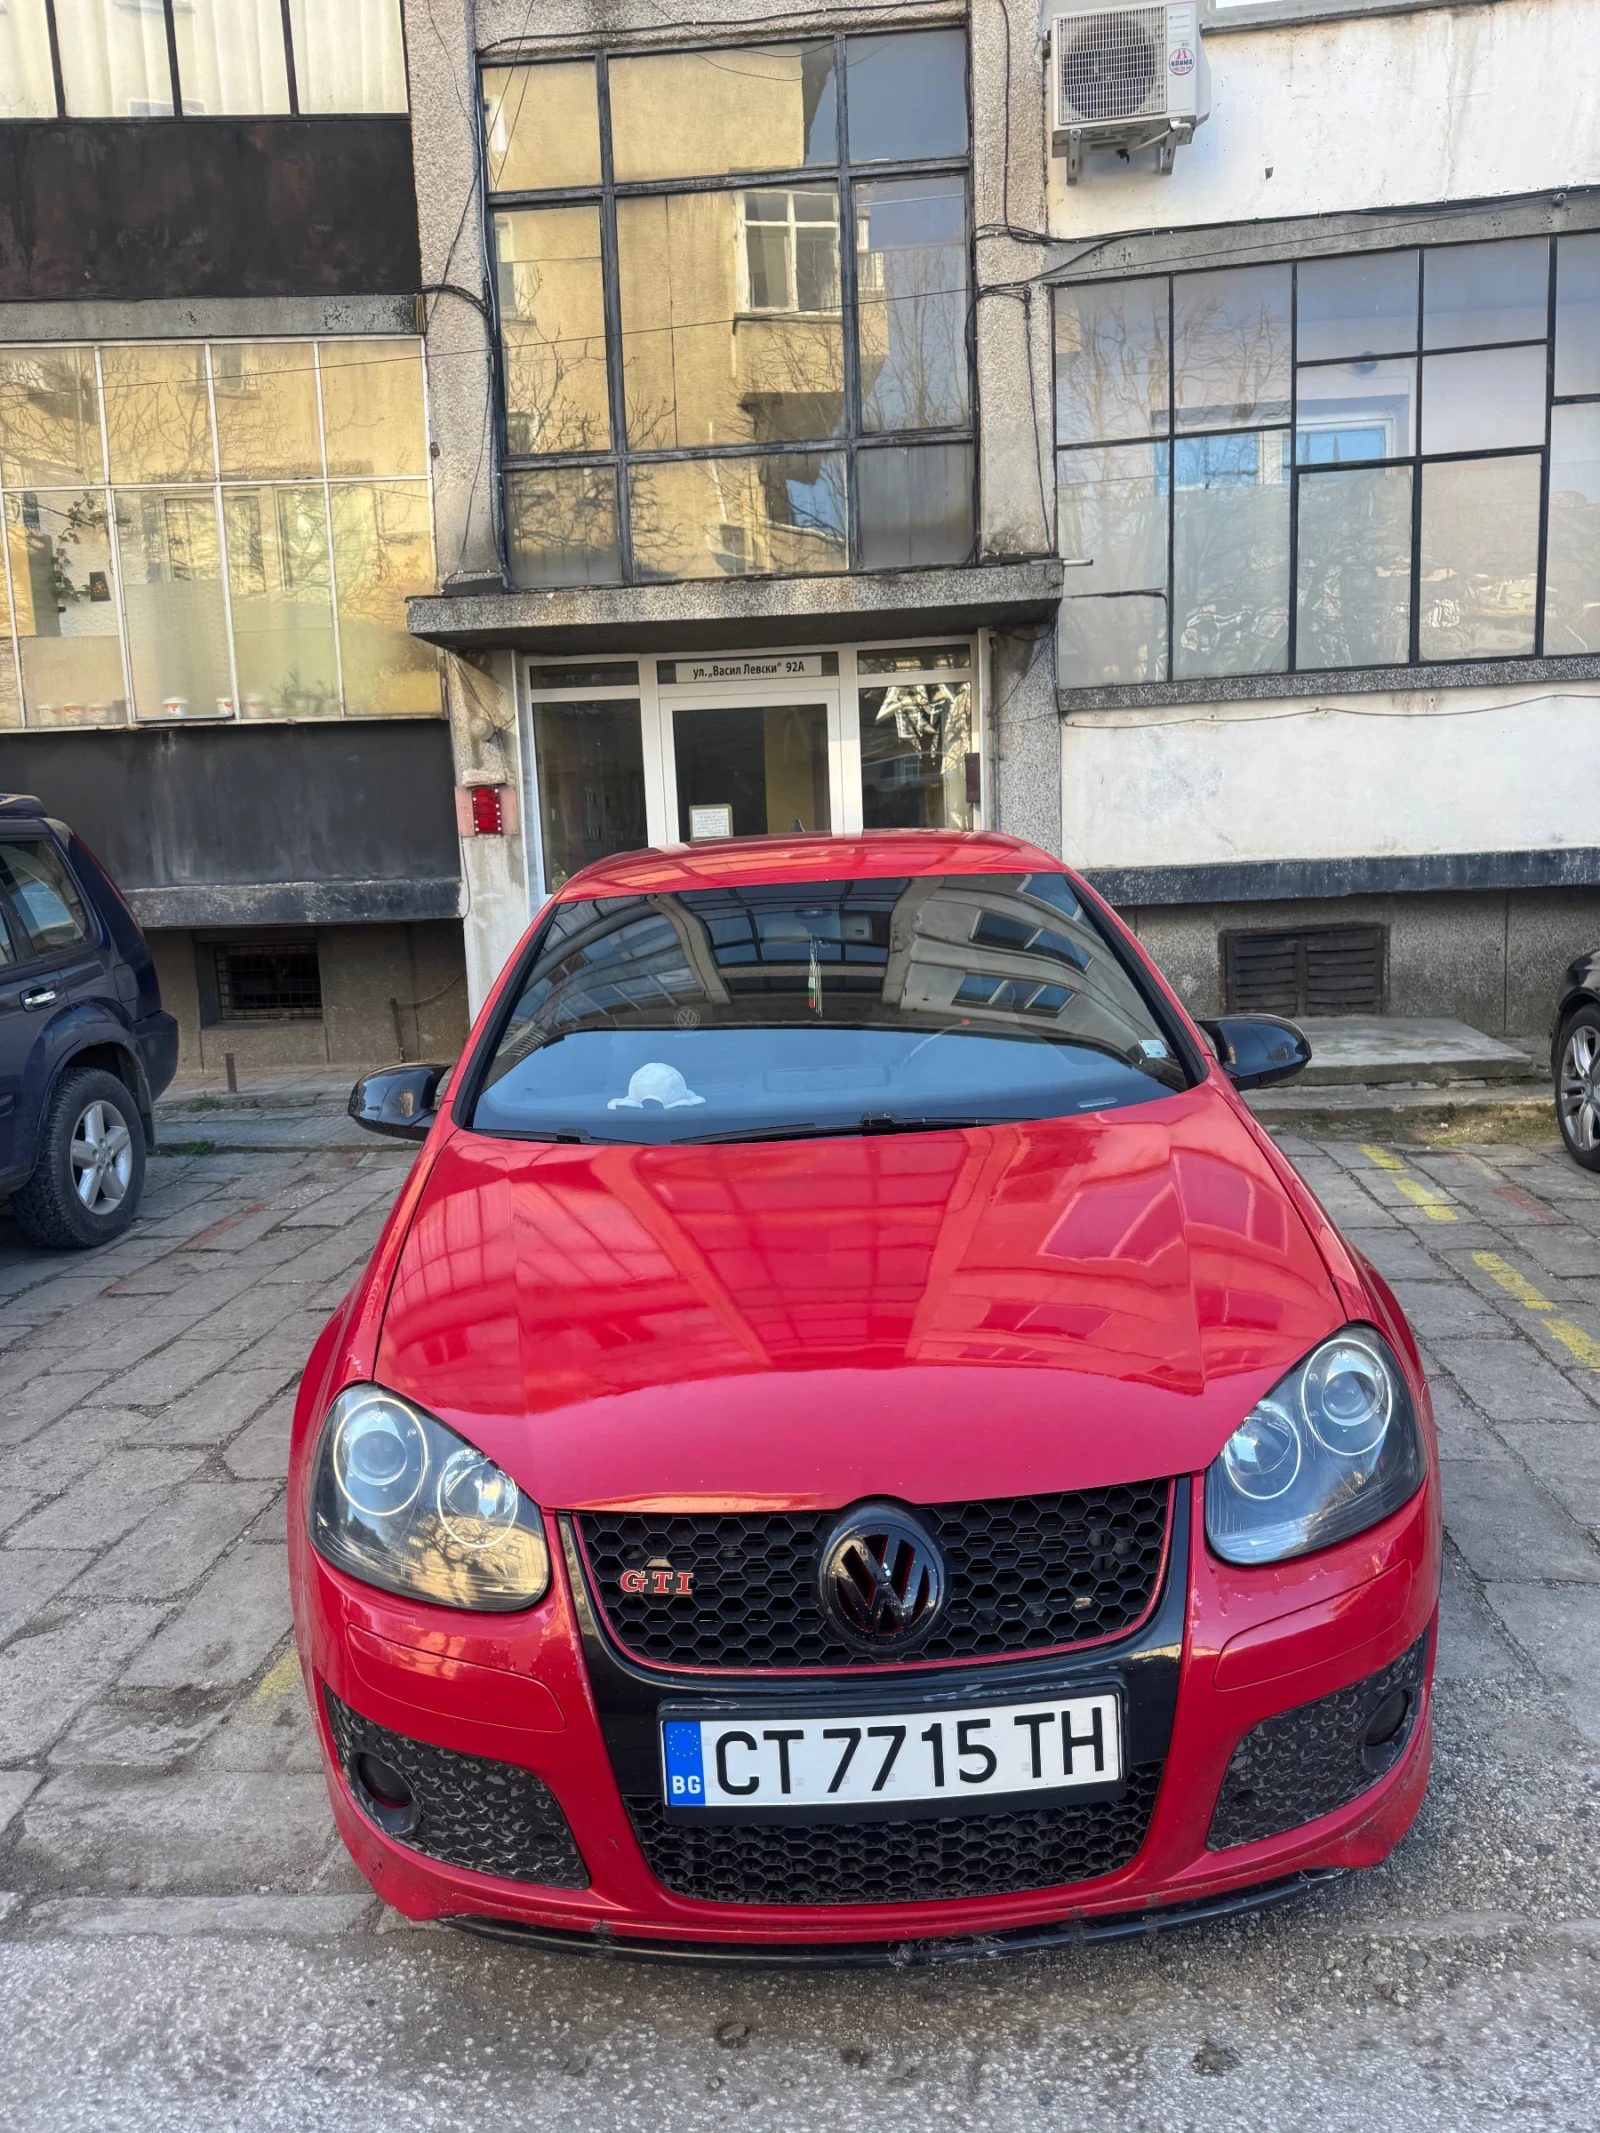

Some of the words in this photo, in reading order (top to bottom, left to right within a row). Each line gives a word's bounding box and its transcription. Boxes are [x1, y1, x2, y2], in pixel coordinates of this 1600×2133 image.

[786, 661, 805, 673] 92А
[619, 1569, 694, 1595] GTI
[832, 1531, 932, 1638] VW
[672, 1776, 702, 1795] BG
[714, 1729, 804, 1796] CT
[822, 1717, 998, 1793] 7715
[1013, 1706, 1105, 1778] TH
